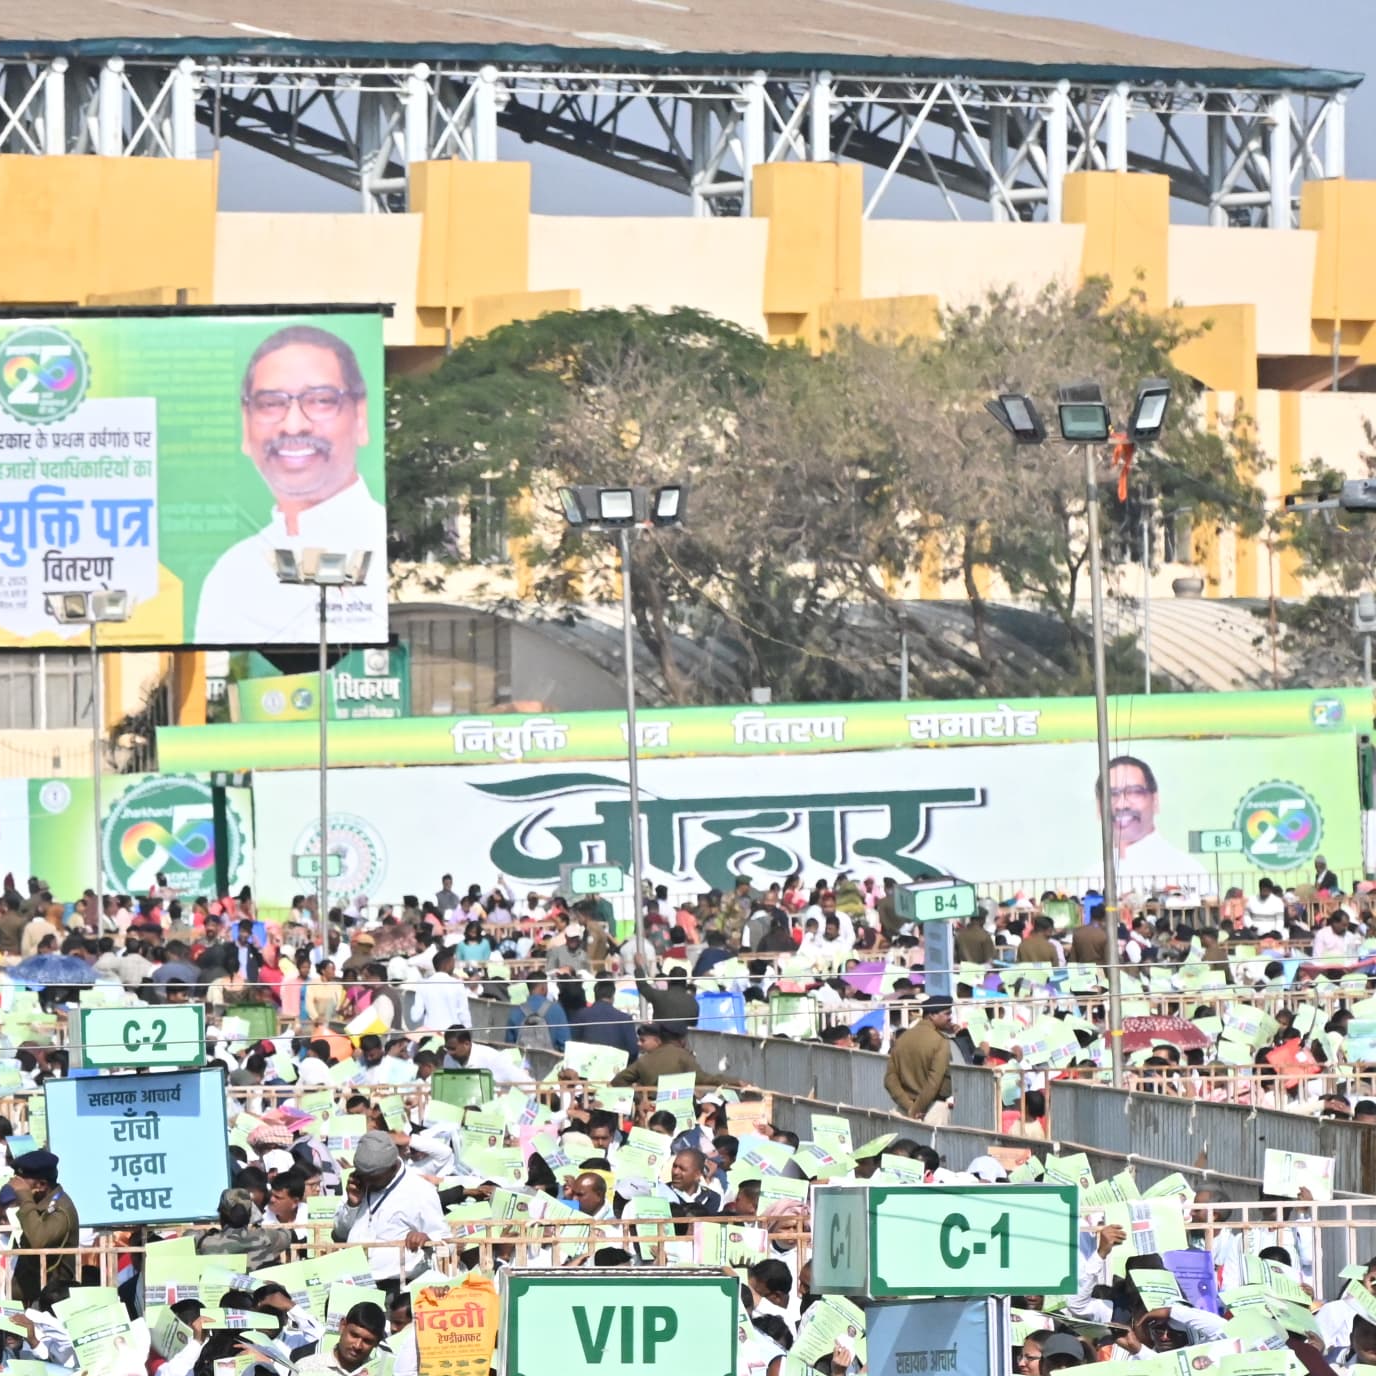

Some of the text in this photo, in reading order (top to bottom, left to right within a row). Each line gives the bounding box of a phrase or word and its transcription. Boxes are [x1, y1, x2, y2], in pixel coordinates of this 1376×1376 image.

[36, 429, 49, 449] के
[52, 432, 85, 449] प्रथम
[134, 431, 152, 448] पर
[39, 455, 131, 479] पदाधिकारियों
[134, 459, 152, 478] का
[92, 498, 153, 547] पत्र
[43, 550, 114, 583] वितरण
[451, 703, 1041, 760] नियुक्ति पत्र वितरण समारोह
[1213, 834, 1232, 848] B-6
[588, 873, 609, 888] B-5
[934, 895, 958, 914] B-4
[123, 1018, 168, 1052] C-2
[88, 1082, 182, 1108] सहायक आचार्य
[110, 1107, 160, 1142] राँची
[109, 1152, 166, 1184] गढ़वा
[108, 1183, 173, 1212] देवघर
[939, 1212, 1010, 1269] C-1
[572, 1305, 678, 1365] VIP
[895, 1342, 958, 1374] सहायक आचार्य
